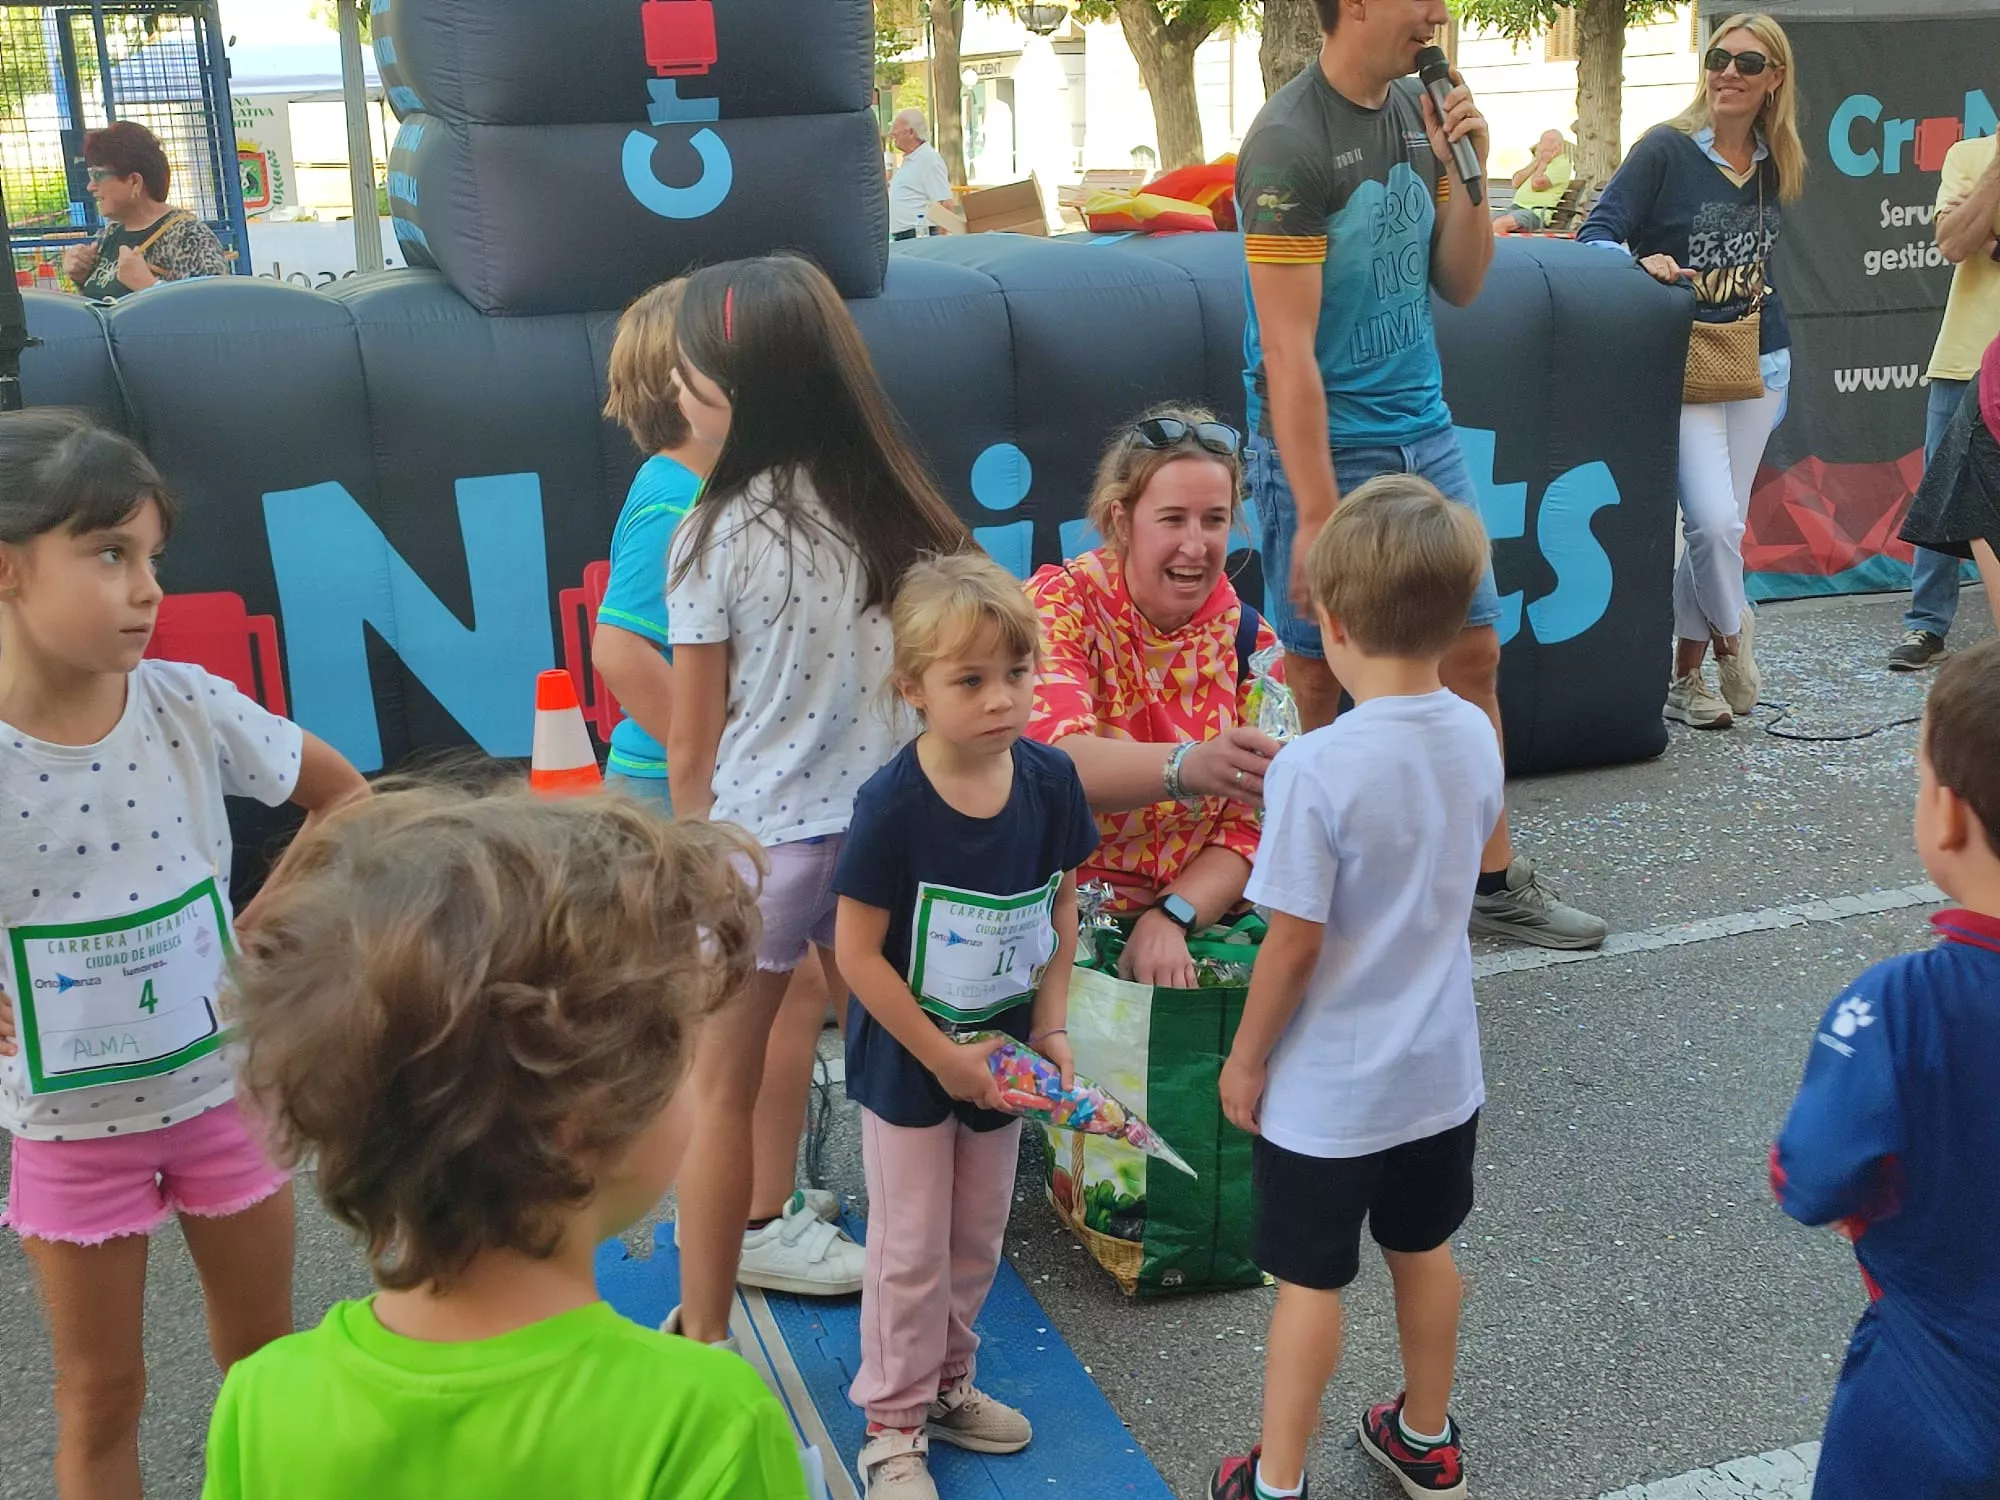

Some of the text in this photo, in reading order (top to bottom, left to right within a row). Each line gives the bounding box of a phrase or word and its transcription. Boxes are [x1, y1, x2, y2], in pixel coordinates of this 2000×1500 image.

[1880, 198, 1935, 229] Serv
[1864, 240, 1950, 276] gestió
[1834, 364, 1930, 393] www.
[949, 903, 1043, 922] CARRERA INFA
[47, 905, 198, 955] CARRERA INFANTIL
[86, 936, 182, 969] CIUDAD DE HUESCA
[992, 946, 1016, 976] 12
[138, 978, 158, 1014] 4
[73, 1032, 140, 1061] ALMA
